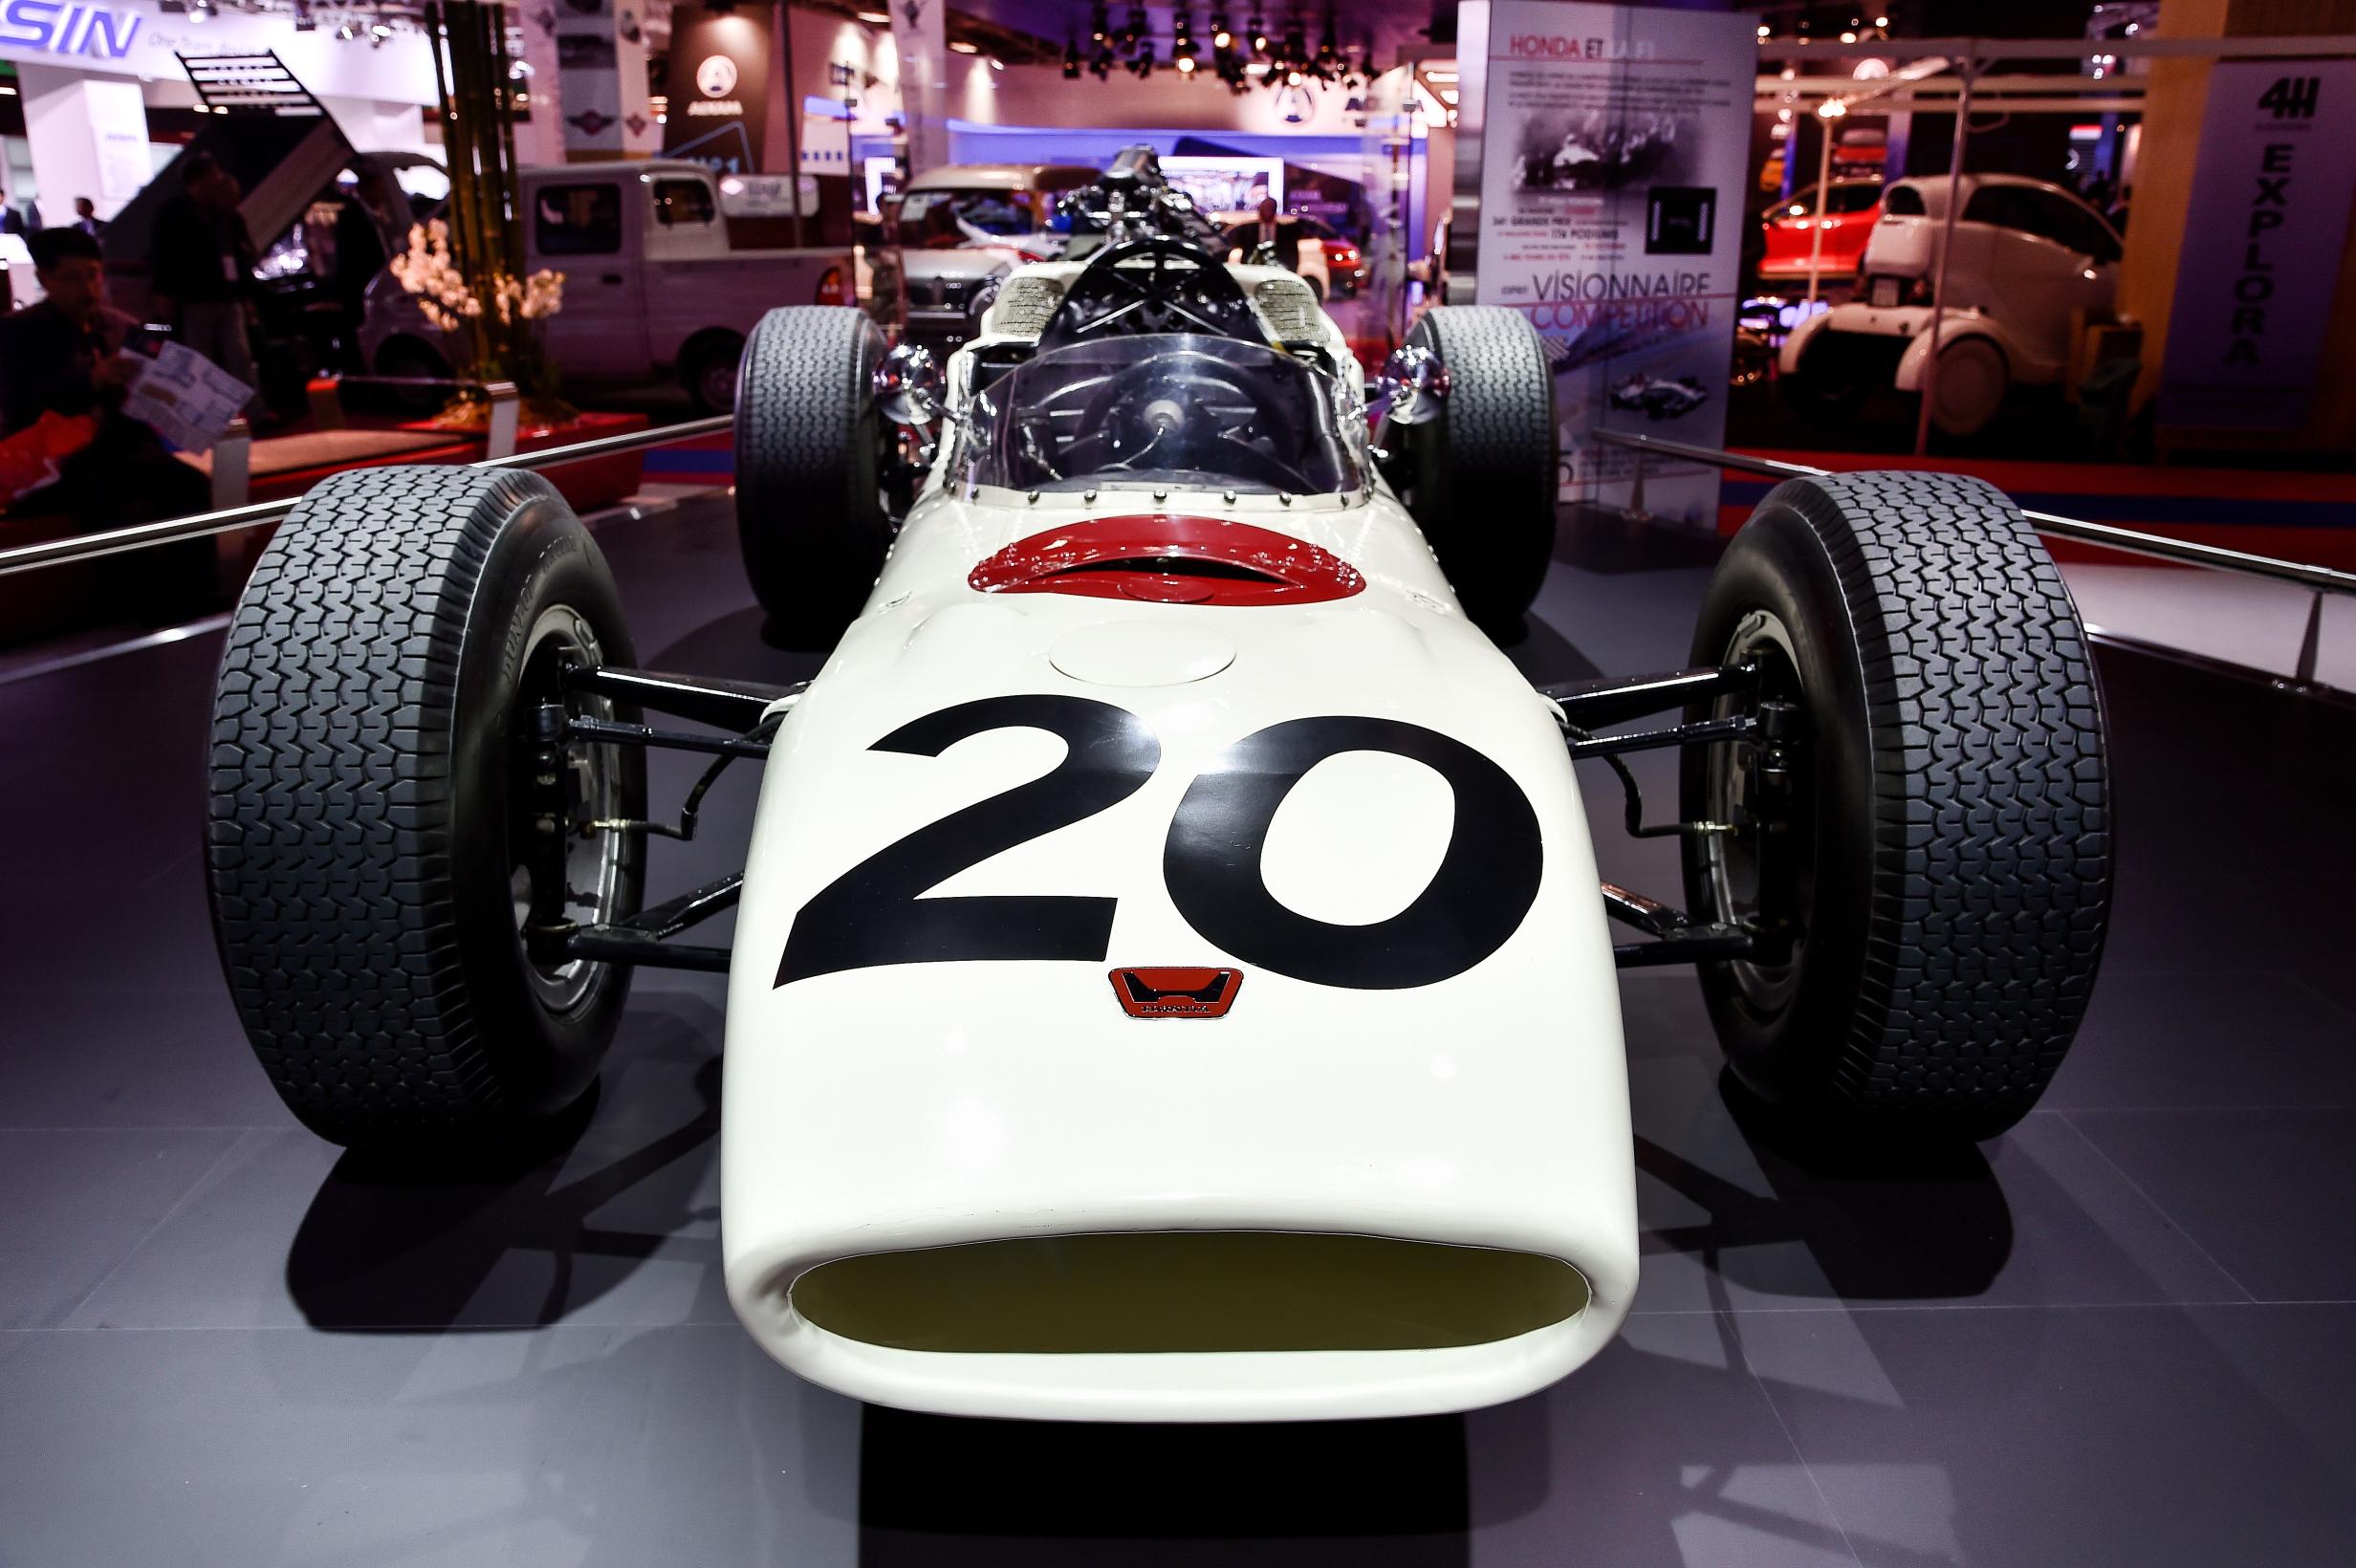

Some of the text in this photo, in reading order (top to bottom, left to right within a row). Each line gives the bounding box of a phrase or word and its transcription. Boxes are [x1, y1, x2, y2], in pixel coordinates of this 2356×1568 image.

[1509, 34, 1581, 57] HONDA
[1583, 38, 1604, 58] ET
[1532, 269, 1711, 301] VISIONNAIRE
[2222, 142, 2294, 368] EXPLORA
[773, 694, 1544, 991] 20
